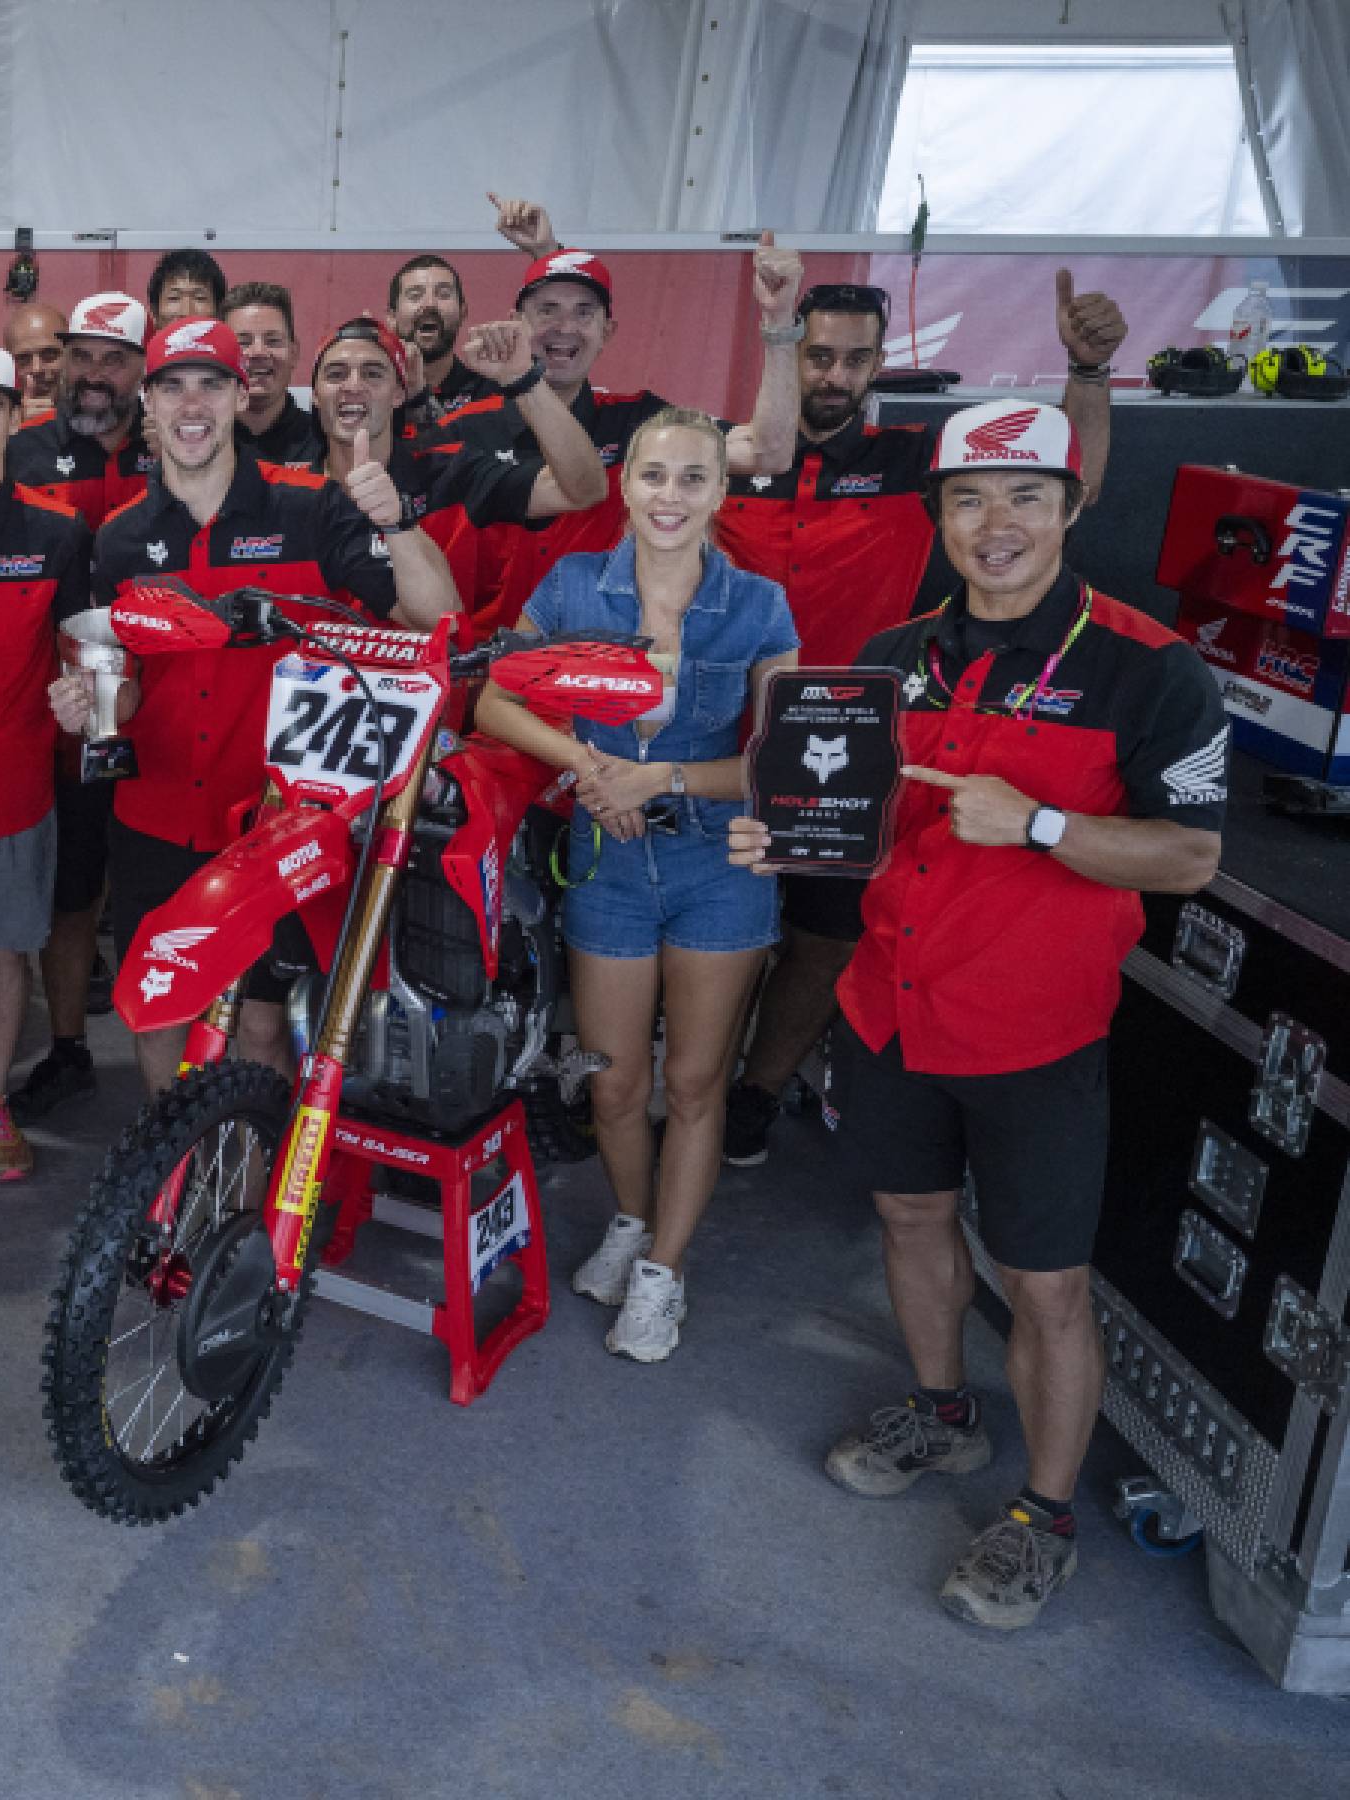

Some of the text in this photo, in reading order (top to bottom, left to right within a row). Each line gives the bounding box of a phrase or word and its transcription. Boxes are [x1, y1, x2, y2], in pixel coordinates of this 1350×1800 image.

[962, 449, 1041, 463] HONDA
[1269, 503, 1340, 589] CRF
[554, 673, 653, 694] ACERBIS
[268, 690, 418, 781] 243
[335, 1126, 431, 1165] TIM GAJSER
[475, 1187, 515, 1256] 243
